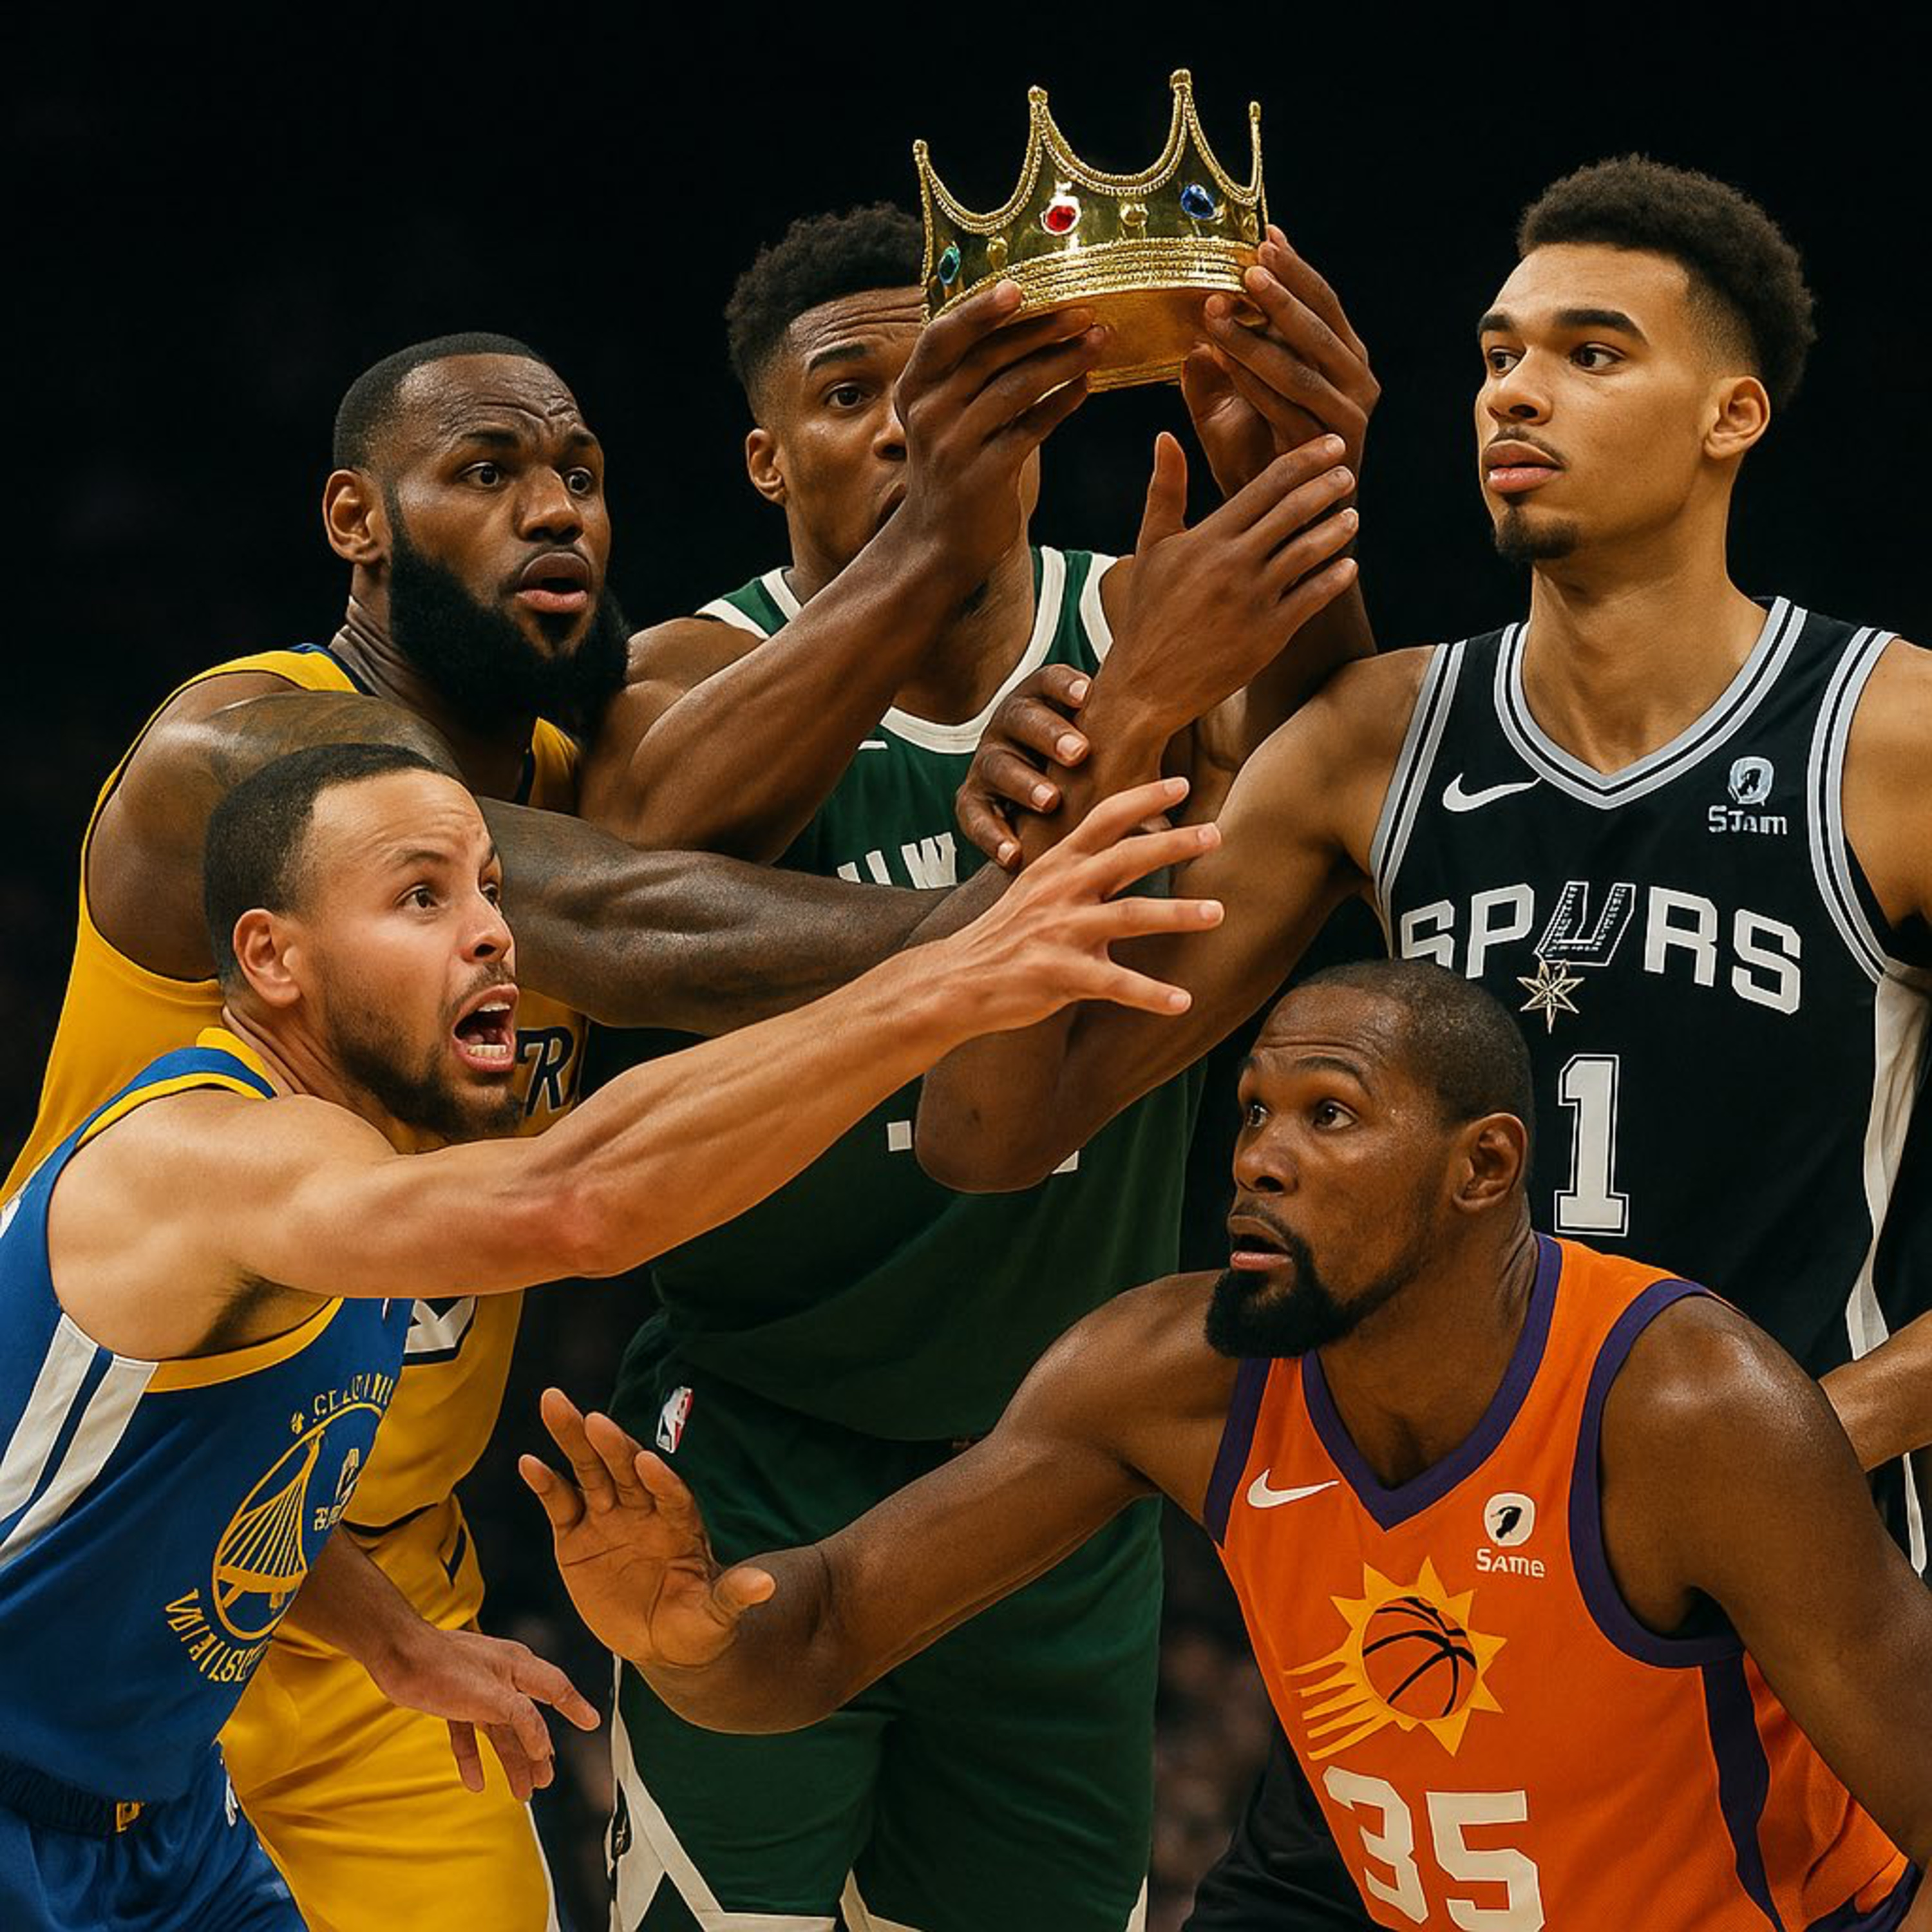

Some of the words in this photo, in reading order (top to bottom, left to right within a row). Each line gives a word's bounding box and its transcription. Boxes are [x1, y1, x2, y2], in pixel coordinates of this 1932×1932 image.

[1400, 880, 1801, 1015] SPURS
[1554, 1054, 1629, 1236] 1
[1322, 1765, 1546, 1932] 35
